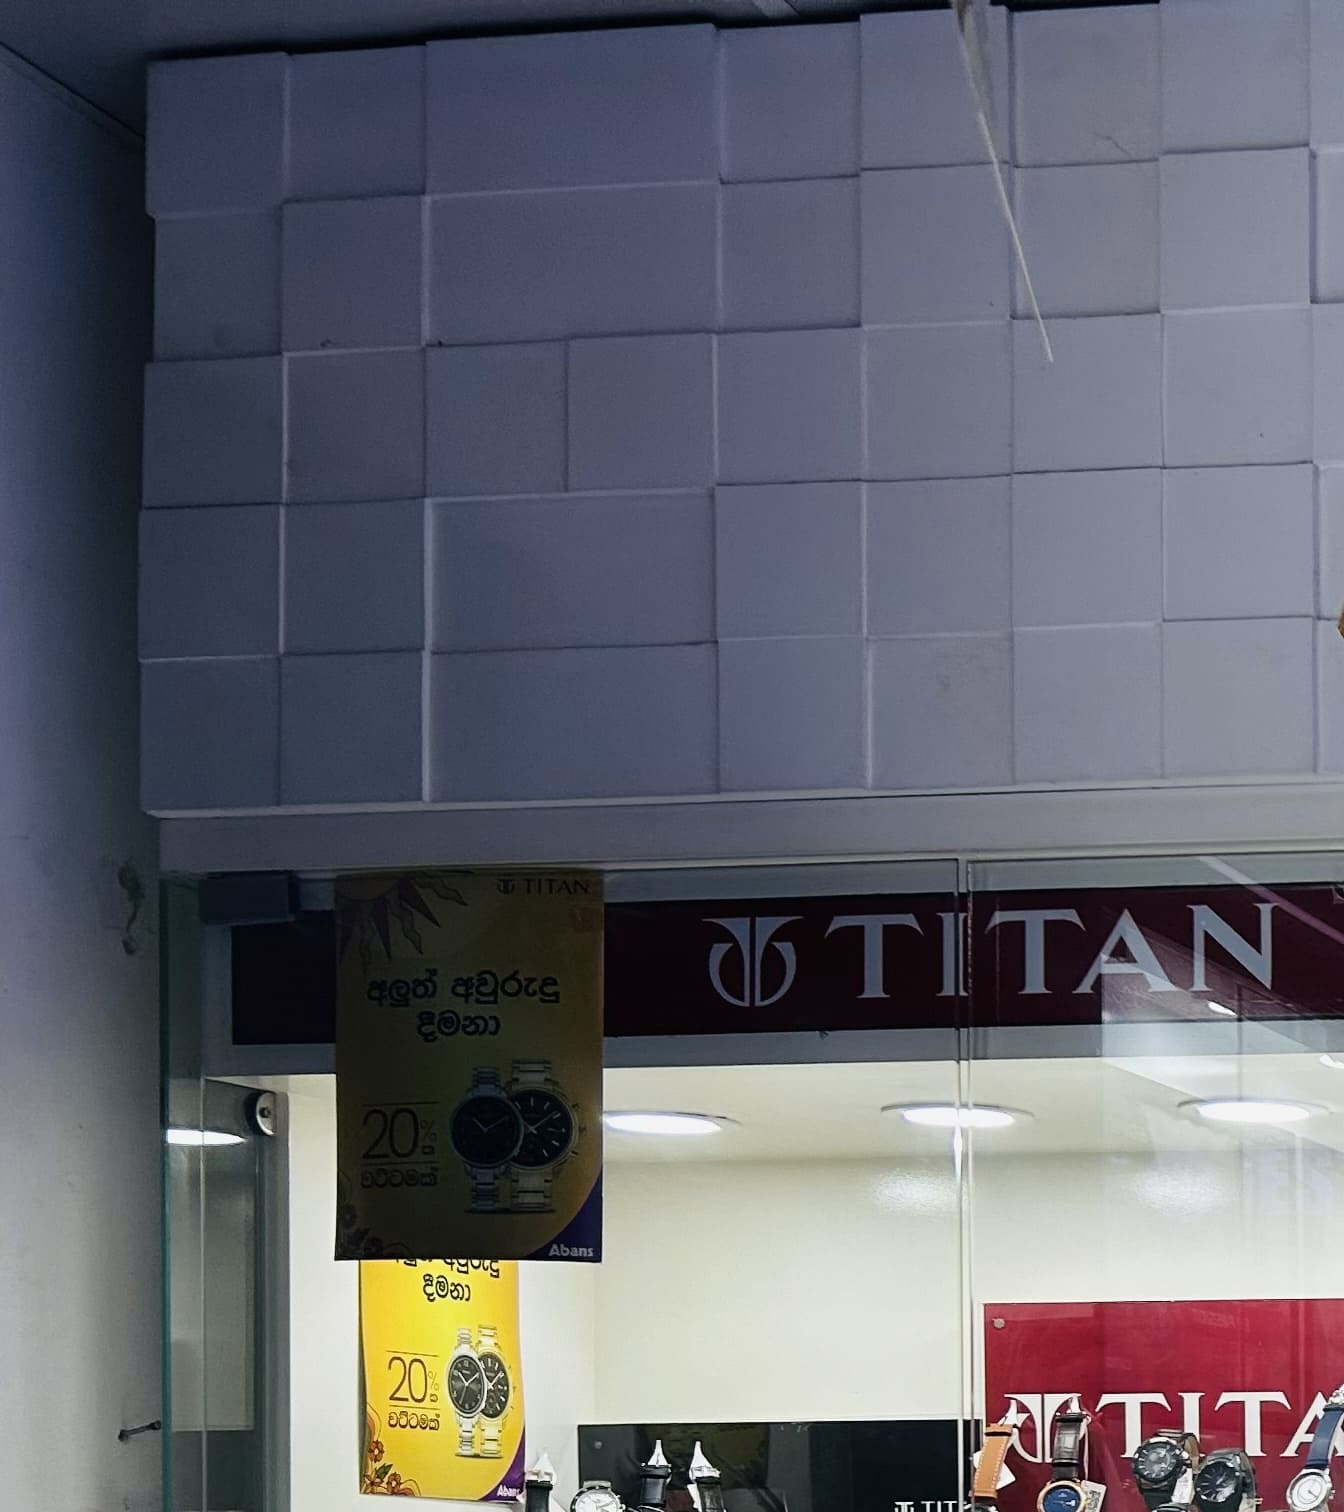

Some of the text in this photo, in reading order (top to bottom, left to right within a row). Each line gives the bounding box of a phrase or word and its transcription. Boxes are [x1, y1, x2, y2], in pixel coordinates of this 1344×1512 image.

[525, 878, 591, 896] TITAN
[824, 902, 1279, 999] TITAN
[548, 1243, 594, 1258] Abans
[497, 1485, 521, 1497] Abans
